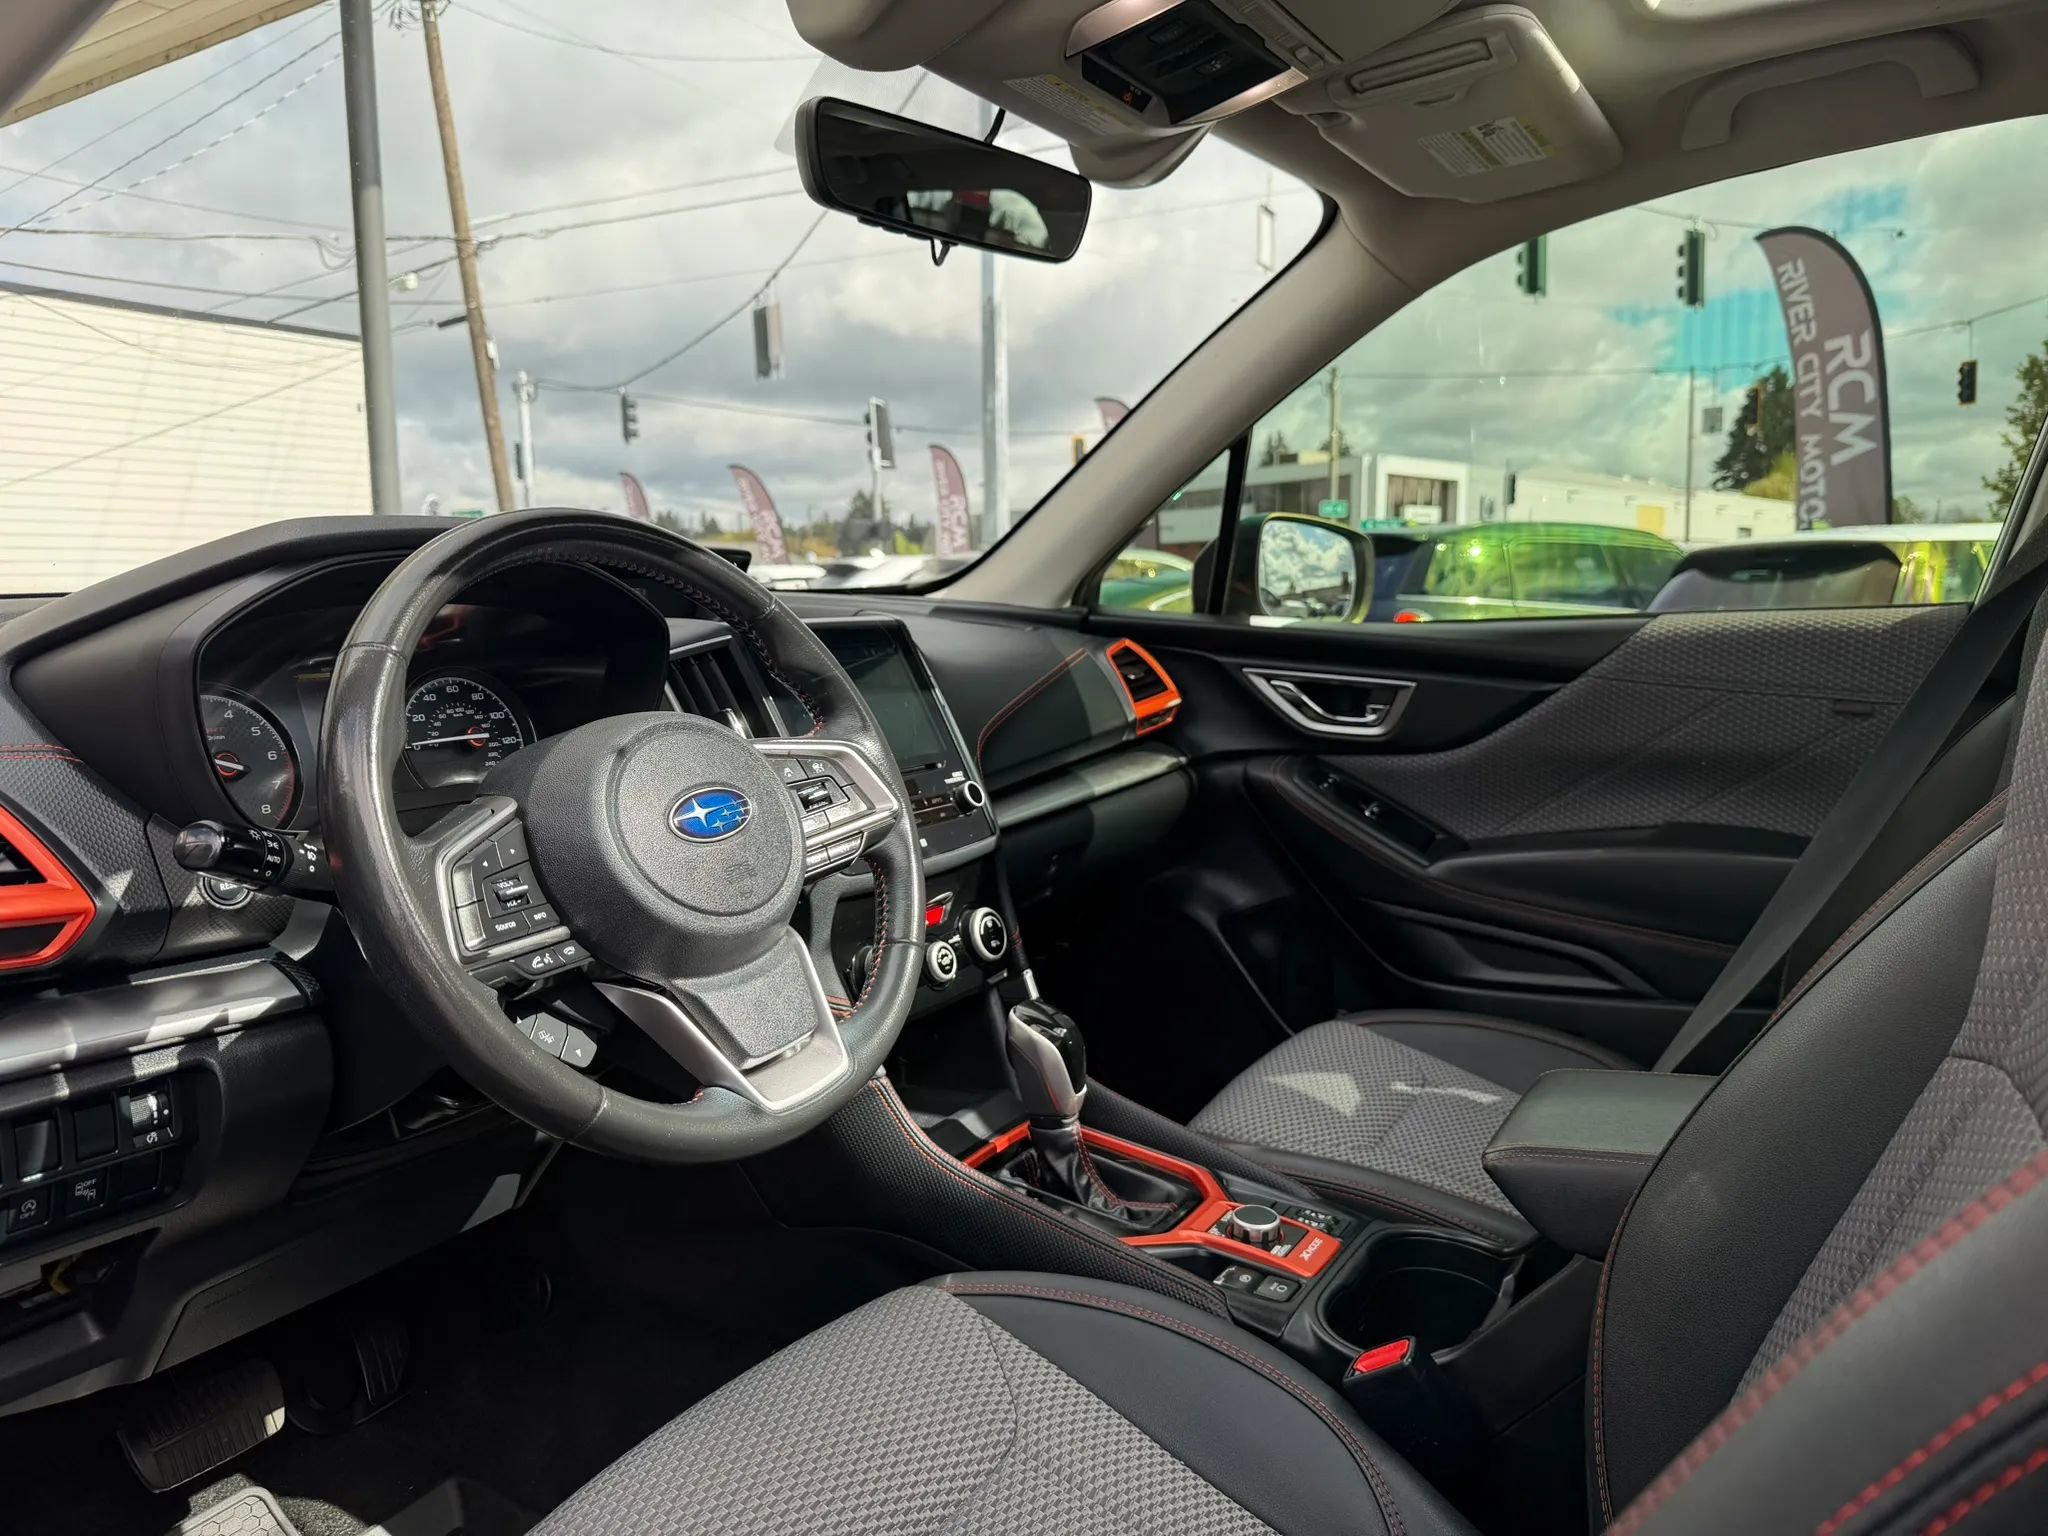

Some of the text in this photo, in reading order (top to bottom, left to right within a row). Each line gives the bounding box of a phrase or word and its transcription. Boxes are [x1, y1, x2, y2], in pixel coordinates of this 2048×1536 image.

[1777, 257, 1816, 344] RIVER
[1796, 353, 1824, 419] CITY
[1823, 329, 1878, 466] RCM
[446, 685, 459, 693] 60
[422, 693, 437, 702] 40
[471, 692, 485, 701] 80
[223, 709, 234, 719] 4
[412, 714, 426, 722] 20
[489, 711, 505, 719] 100
[251, 726, 261, 736] 5
[502, 736, 517, 744] 120
[267, 750, 278, 761] 6
[271, 780, 281, 790] 7
[261, 804, 272, 814] 8
[266, 854, 281, 864] AUTO
